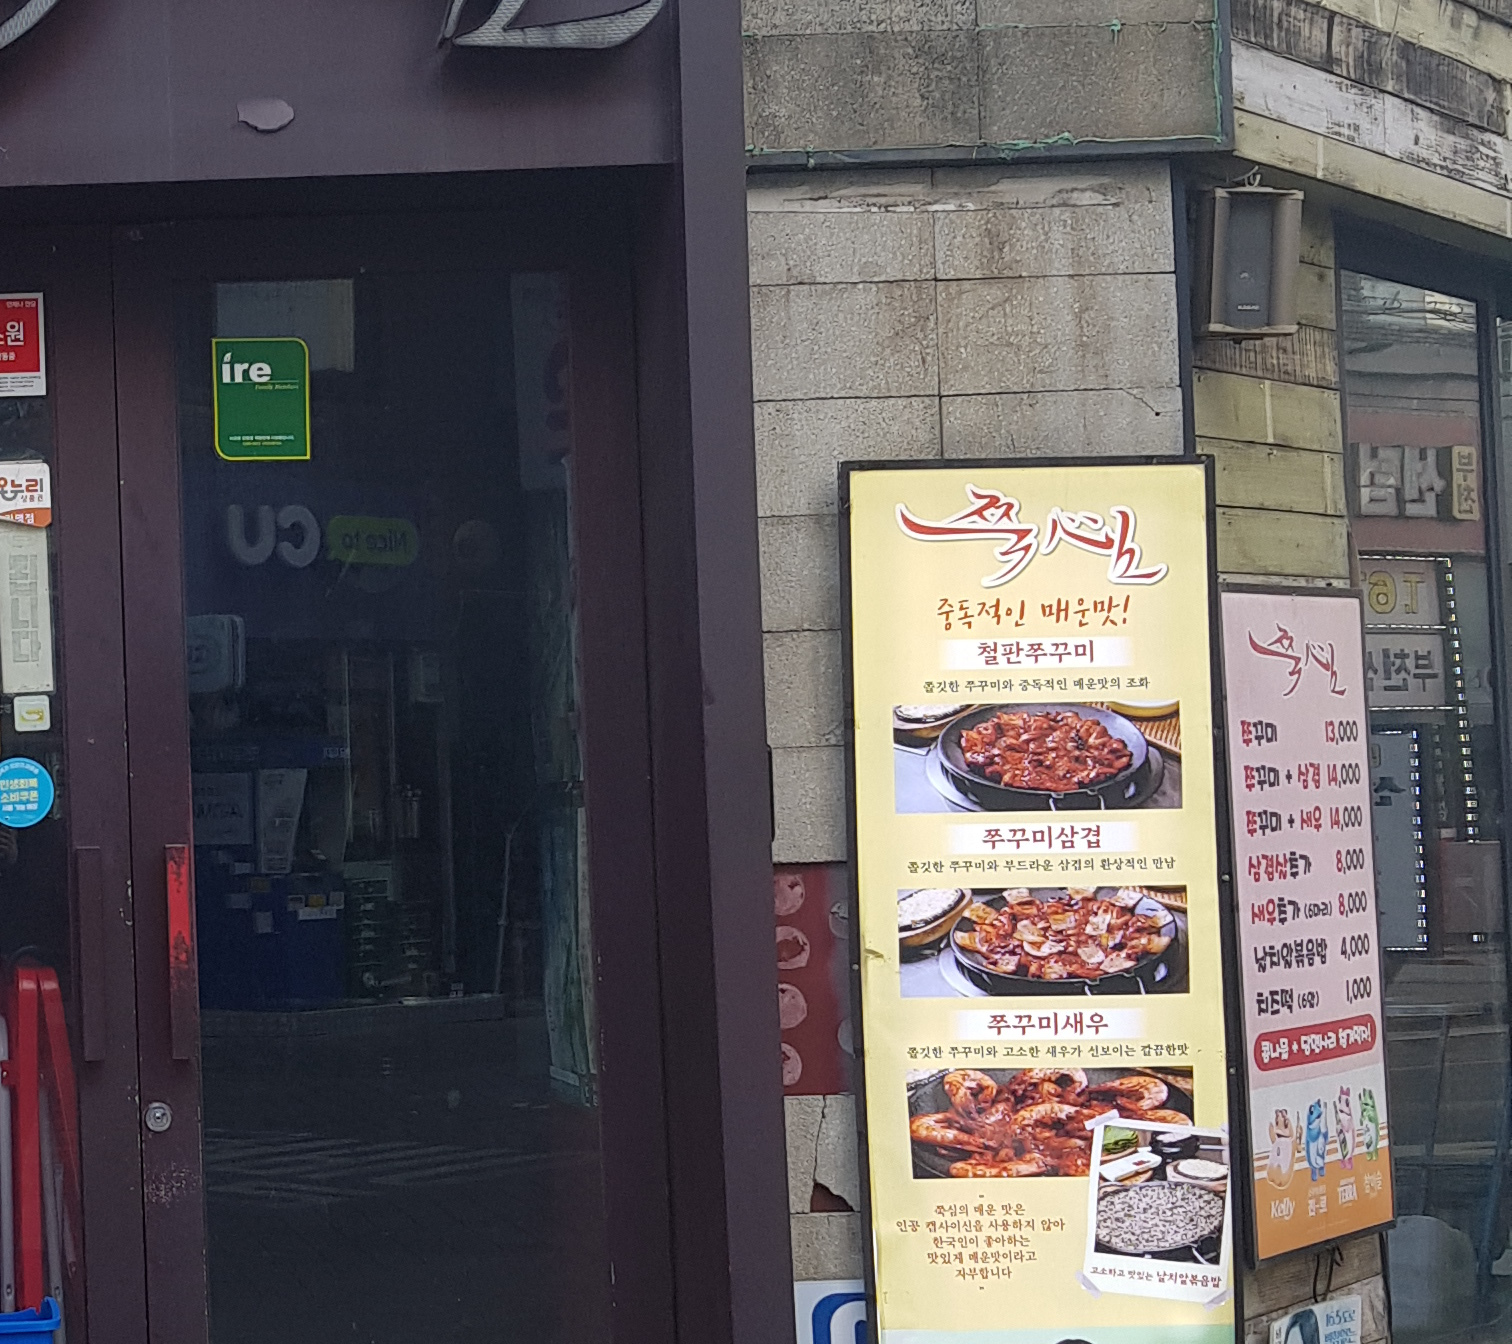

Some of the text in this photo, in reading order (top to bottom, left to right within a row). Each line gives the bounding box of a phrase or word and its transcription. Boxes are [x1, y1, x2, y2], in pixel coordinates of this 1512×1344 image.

[937, 595, 1130, 631] 중독적인 매운맛!
[977, 639, 1095, 665] 철판쭈꾸미
[964, 679, 1014, 693] 쭈꾸미와
[1018, 678, 1068, 692] 중독적인
[1073, 677, 1121, 691] 매운맛의
[1125, 676, 1151, 690] 조화
[1325, 720, 1358, 745] 13,000
[1298, 762, 1320, 789] 삼겹
[1327, 763, 1360, 788] 14,000
[1301, 806, 1322, 832] 새우
[1330, 805, 1362, 831] 14,000
[982, 825, 1101, 850] 쭈꾸미삼겹
[1100, 858, 1147, 871] 환상적인
[1152, 857, 1176, 870] 만남
[1248, 848, 1364, 882] 삼겹살추가 8,000
[1252, 897, 1300, 926] 새우추가
[1338, 891, 1367, 918] 8,000
[1254, 933, 1370, 973] 날치알볶음밥 4,000
[1256, 988, 1293, 1016] 치즈떡
[1346, 976, 1372, 1004] 1,000
[987, 1011, 1109, 1036] 쭈꾸미새우
[1002, 1045, 1040, 1057] 고소한
[1045, 1044, 1083, 1058] 새우가
[974, 1204, 996, 1216] 매운
[1001, 1203, 1026, 1216] 맛은
[1271, 1197, 1295, 1220] Kelly
[896, 1220, 920, 1233] 인공
[988, 1218, 1035, 1232] 사용하지
[1040, 1218, 1065, 1232] 않아
[933, 1234, 1031, 1249] 한국인이 좋아하는
[927, 1250, 1037, 1265] 맛있게 매운맛이라고
[955, 1266, 1012, 1281] 자부합니다
